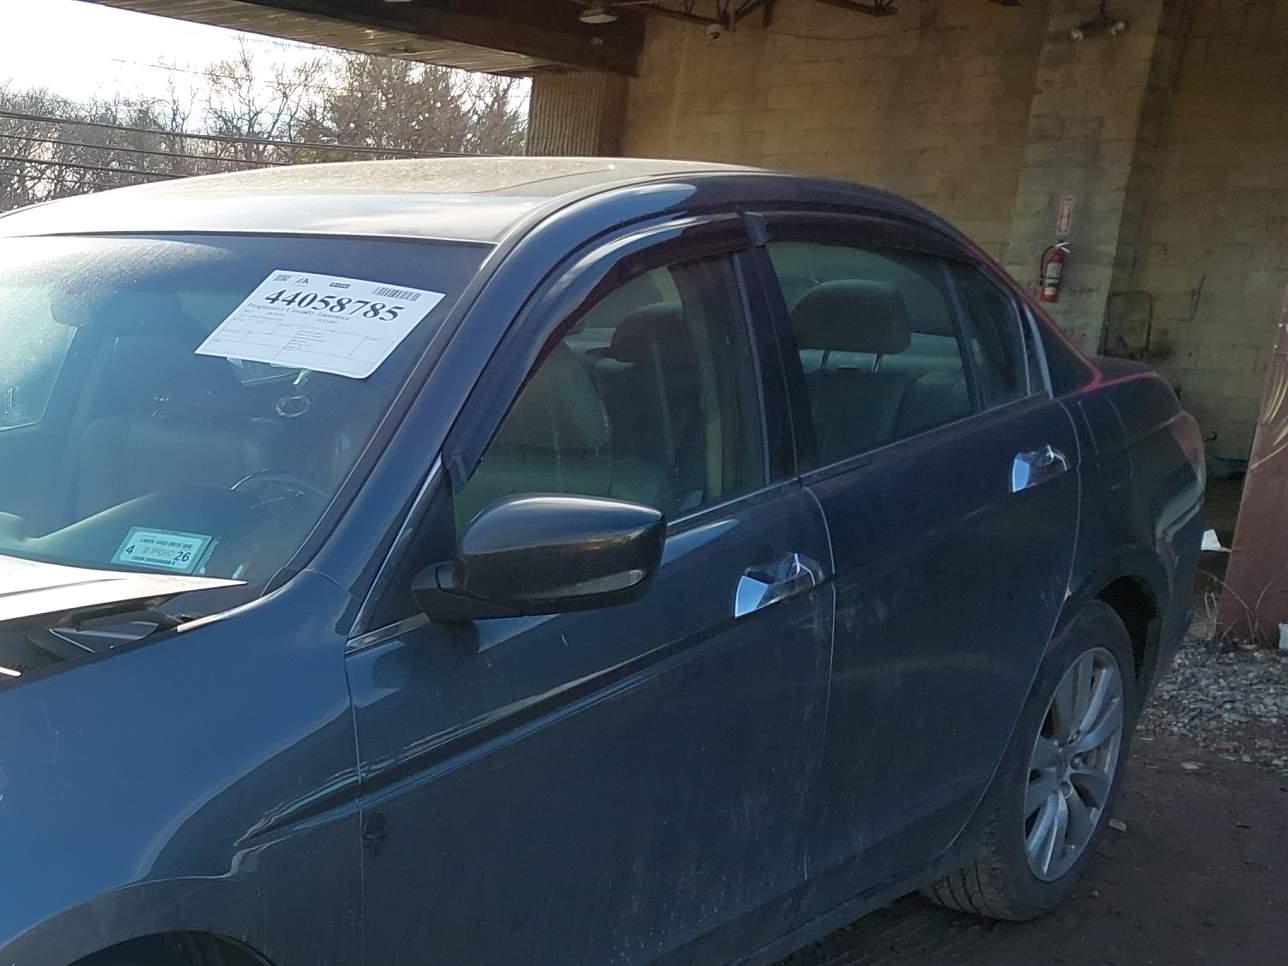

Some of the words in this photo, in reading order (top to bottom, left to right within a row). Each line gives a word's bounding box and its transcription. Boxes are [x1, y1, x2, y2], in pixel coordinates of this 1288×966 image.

[265, 289, 405, 322] 44058785
[125, 544, 137, 555] 4
[174, 551, 192, 562] 26
